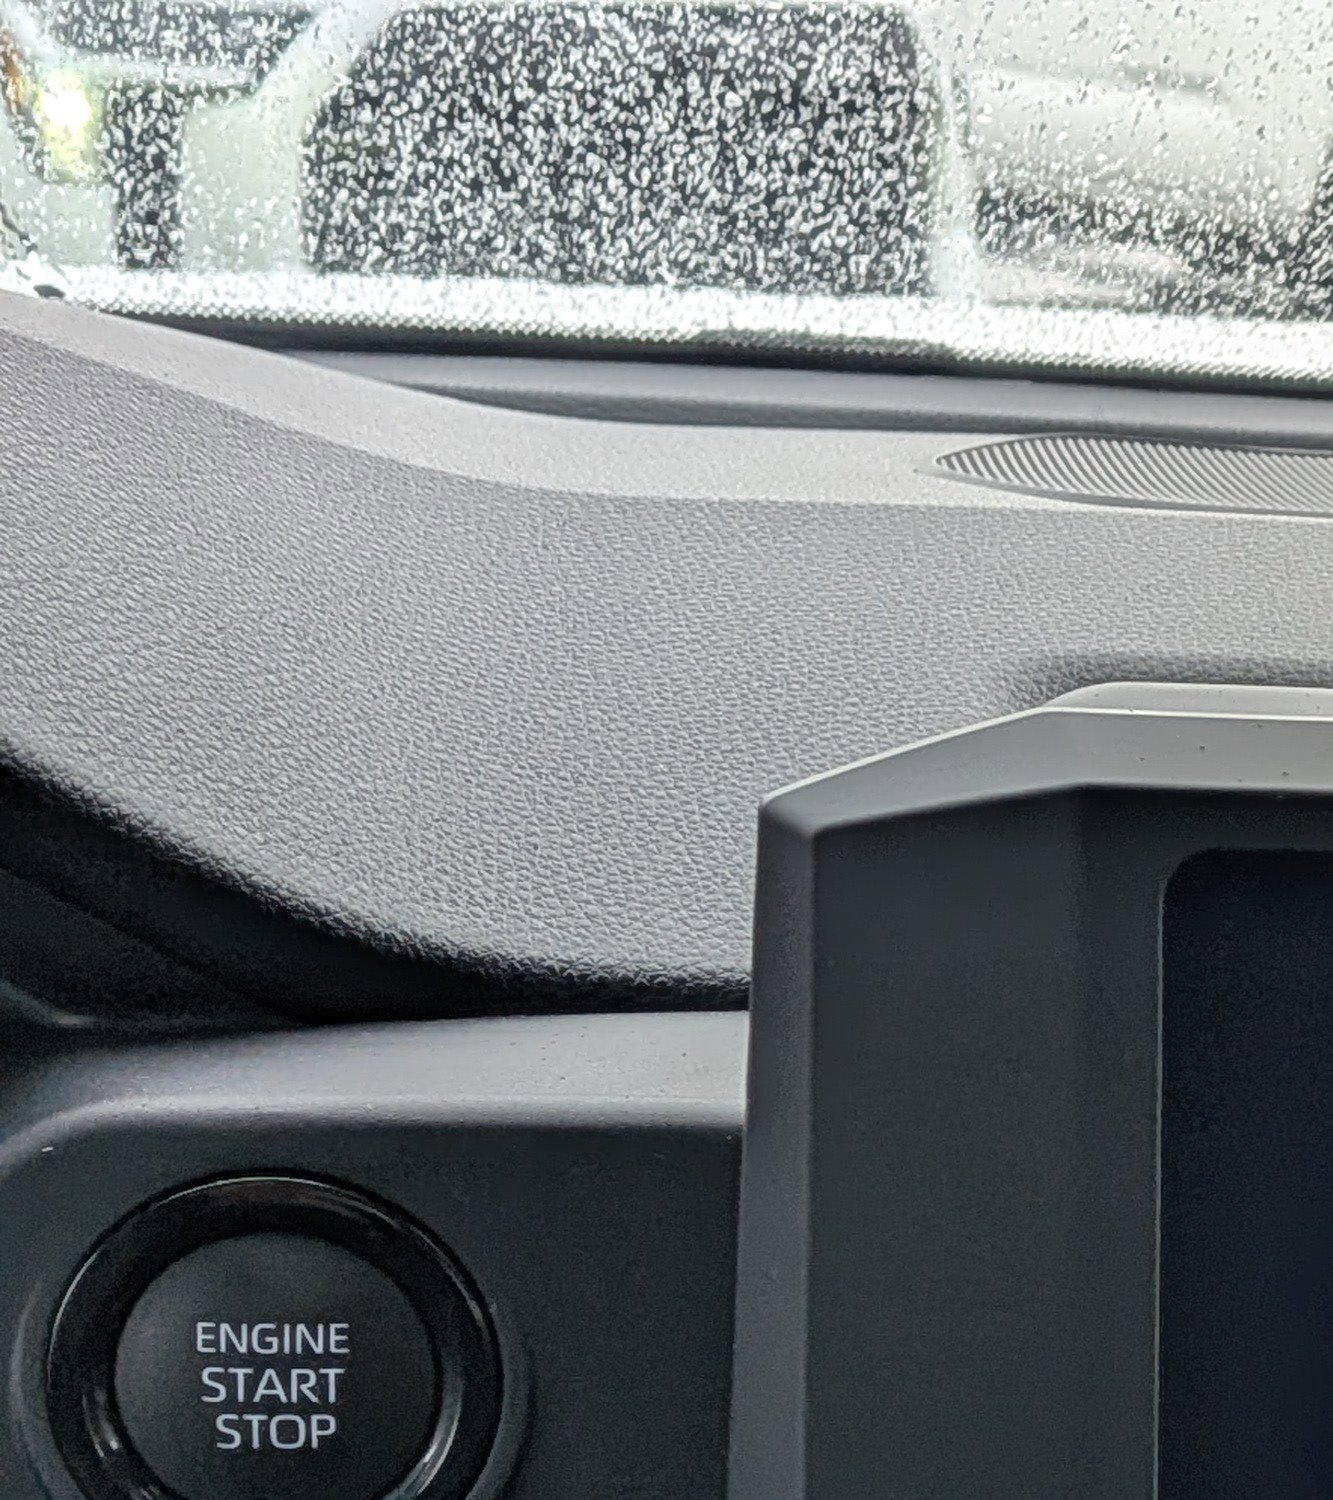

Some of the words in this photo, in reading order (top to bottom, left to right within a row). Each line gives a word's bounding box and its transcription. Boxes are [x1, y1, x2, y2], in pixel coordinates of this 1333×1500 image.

[195, 1321, 350, 1355] ENGINE
[200, 1366, 346, 1404] START
[215, 1413, 337, 1450] STOP
